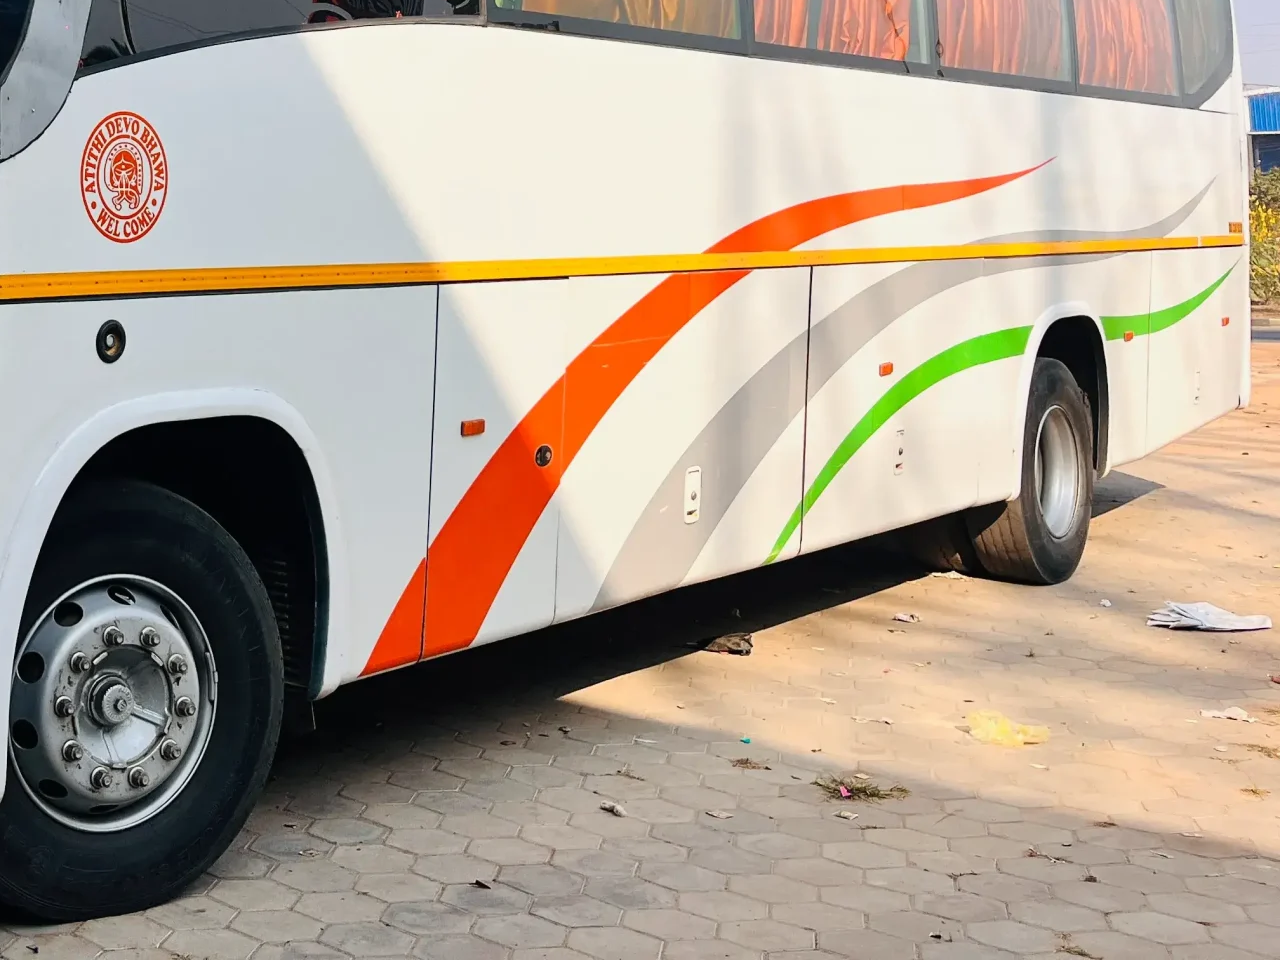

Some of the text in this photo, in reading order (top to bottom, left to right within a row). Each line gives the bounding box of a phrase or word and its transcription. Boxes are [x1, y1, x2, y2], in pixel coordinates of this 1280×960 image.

[84, 116, 165, 194] ATITHI DEVO BHAWA
